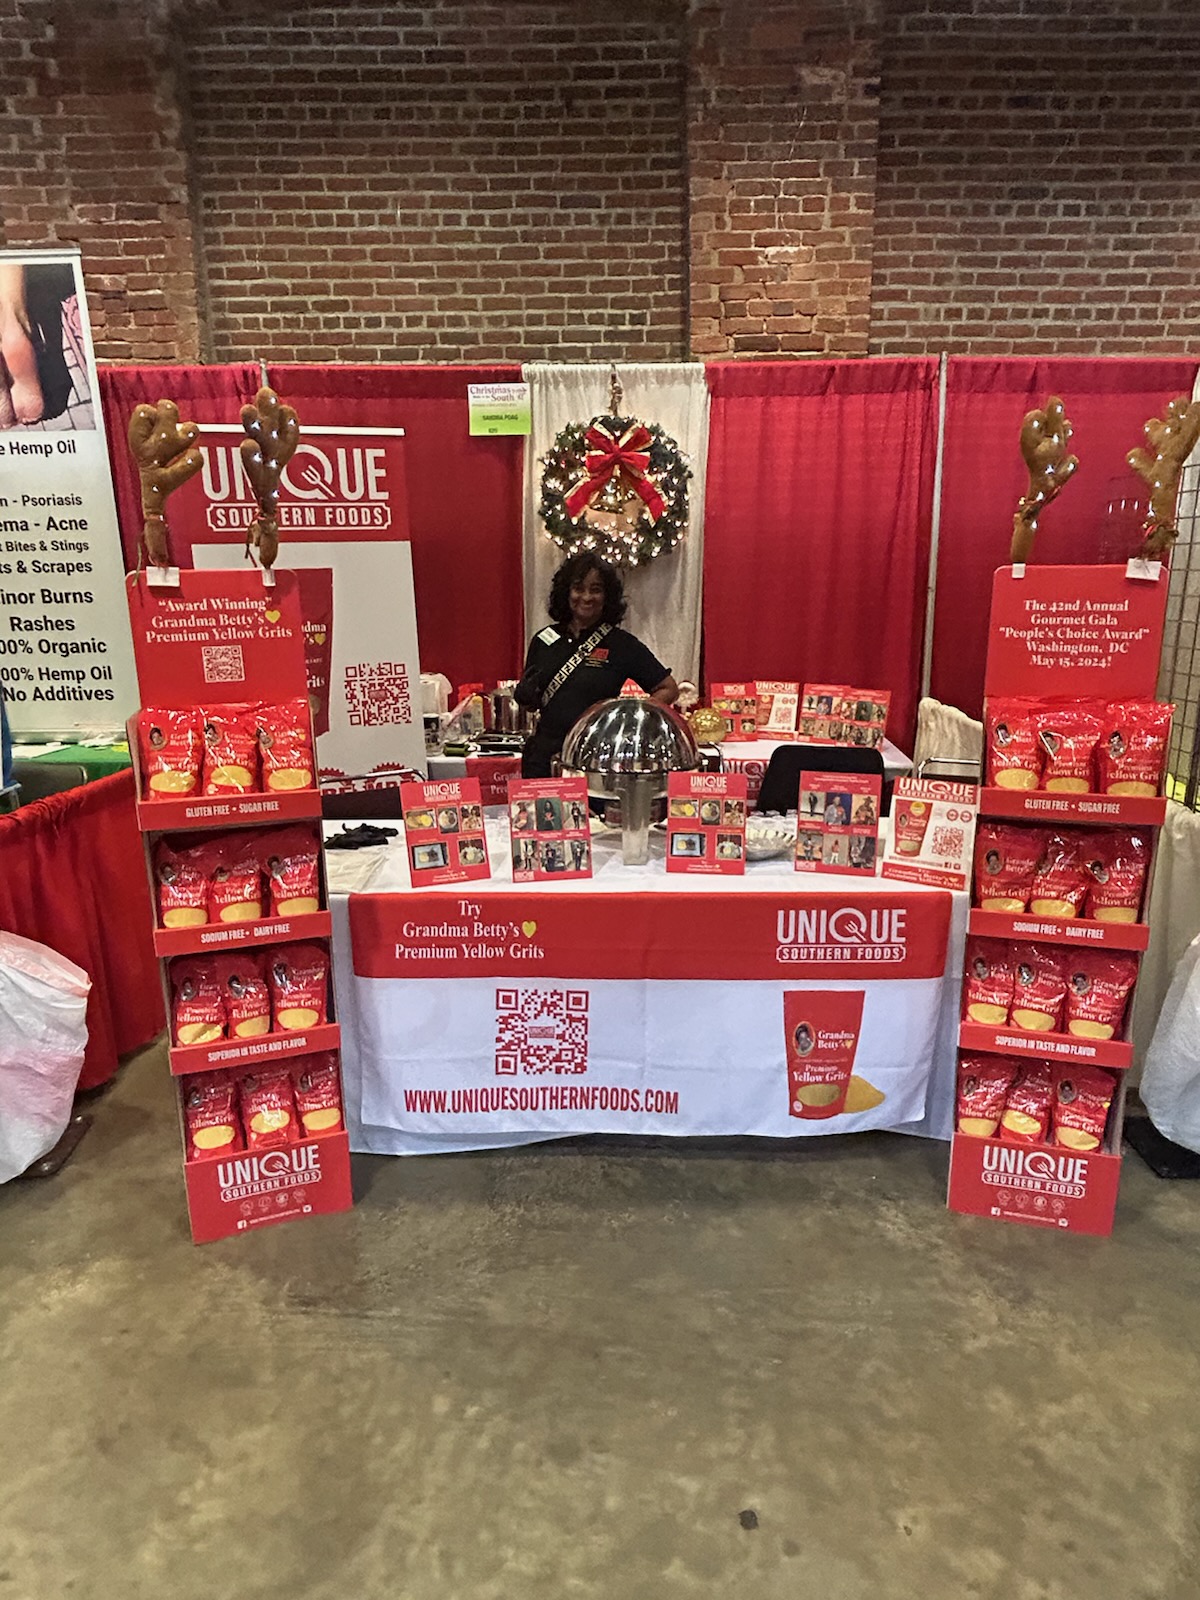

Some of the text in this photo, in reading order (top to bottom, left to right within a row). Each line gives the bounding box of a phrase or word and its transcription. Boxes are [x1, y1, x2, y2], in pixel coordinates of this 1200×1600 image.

[470, 385, 510, 395] Christmas
[490, 394, 514, 402] South
[9, 441, 53, 457] Hemp
[57, 439, 76, 454] Oil
[22, 493, 83, 507] Psoriasis
[46, 516, 88, 531] Acne
[325, 507, 383, 525] FOODS
[5, 540, 89, 553] Bites & Stings
[16, 560, 27, 574] &
[31, 560, 93, 576] Scrapes
[40, 588, 94, 604] Burns
[1024, 600, 1129, 613] The 42nd Annual
[9, 615, 75, 632] Rashes
[151, 613, 217, 629] Grandma
[1030, 613, 1118, 625] Gourmet Gala
[145, 625, 292, 643] Premium Yellow Grits
[1056, 627, 1099, 639] Choice
[38, 637, 107, 657] Organic
[1109, 642, 1130, 653] DC
[1029, 655, 1056, 669] May
[1077, 656, 1112, 668] 2024!
[38, 667, 86, 683] Hemp
[90, 665, 112, 680] Oil
[3, 686, 114, 701] No Additives
[756, 682, 797, 691] UNIQUE
[423, 783, 461, 797] UNIQUE
[690, 775, 728, 789] UNIQUE
[899, 777, 975, 797] UNIQUE
[186, 801, 280, 818] GLUTEN FREE SUGAR FREE
[1025, 798, 1121, 814] GLUTEN FREE SUGAR FREE
[458, 900, 482, 920] Try
[201, 923, 290, 944] SODIUM FREE DAIRY FREE
[403, 921, 520, 941] Grandma Betty’s
[777, 907, 906, 944] UNIQUE
[1013, 921, 1104, 939] SODIUM FREE DAIRY FREE
[395, 943, 545, 959] Premium Yellow Grits
[782, 947, 900, 960] SOUTHERN FOODS
[818, 1029, 855, 1040] Grandma
[207, 1037, 307, 1062] SUPERIOR IN TASTE AND FLAVOR
[995, 1036, 1096, 1057] SUPERIOR IN TASTE AND FLAVOR
[805, 1064, 838, 1072] Premium
[793, 1071, 825, 1082] Yellow
[404, 1086, 679, 1114] WWW.UNIQUESOUTHERNFOODS.COM
[217, 1145, 321, 1188] UNIQUE
[982, 1145, 1089, 1185] UNIQUE
[225, 1171, 317, 1200] SOUTHERN FOODS
[986, 1172, 1080, 1196] SOUTHERN FOODS
